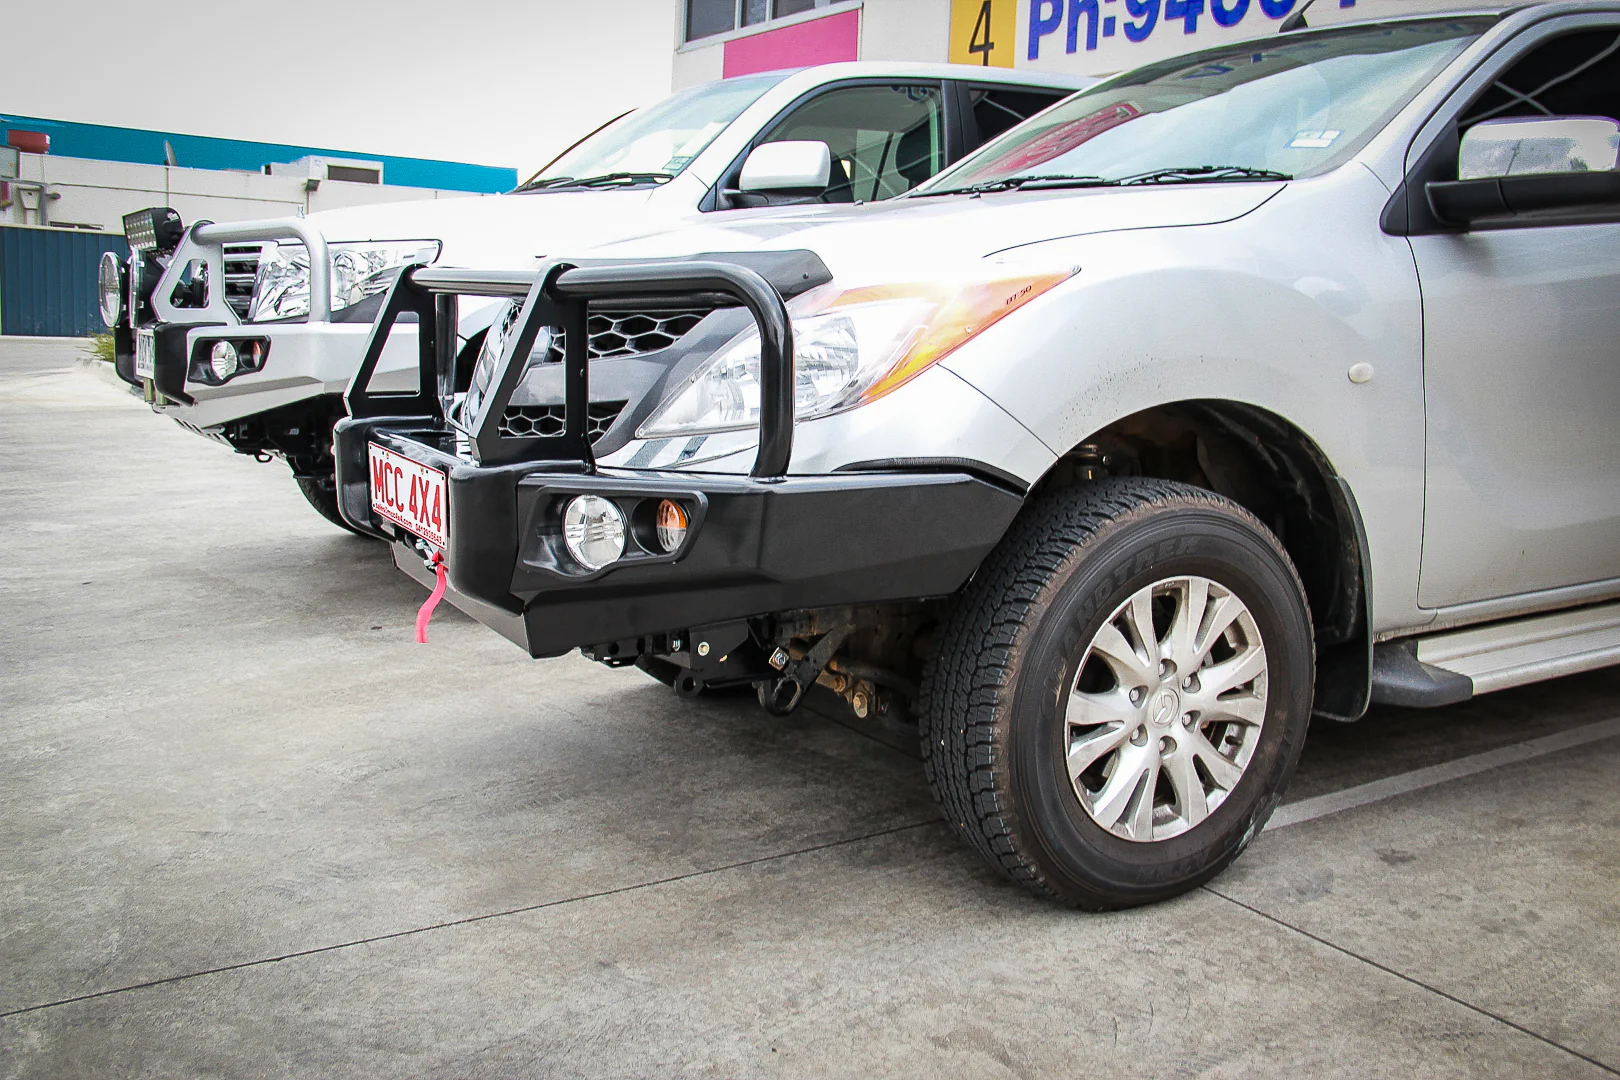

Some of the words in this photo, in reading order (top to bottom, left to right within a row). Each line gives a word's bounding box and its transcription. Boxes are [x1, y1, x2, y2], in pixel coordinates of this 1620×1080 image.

[968, 0, 994, 67] 4
[372, 455, 404, 513] MCC
[408, 473, 442, 533] 4X4
